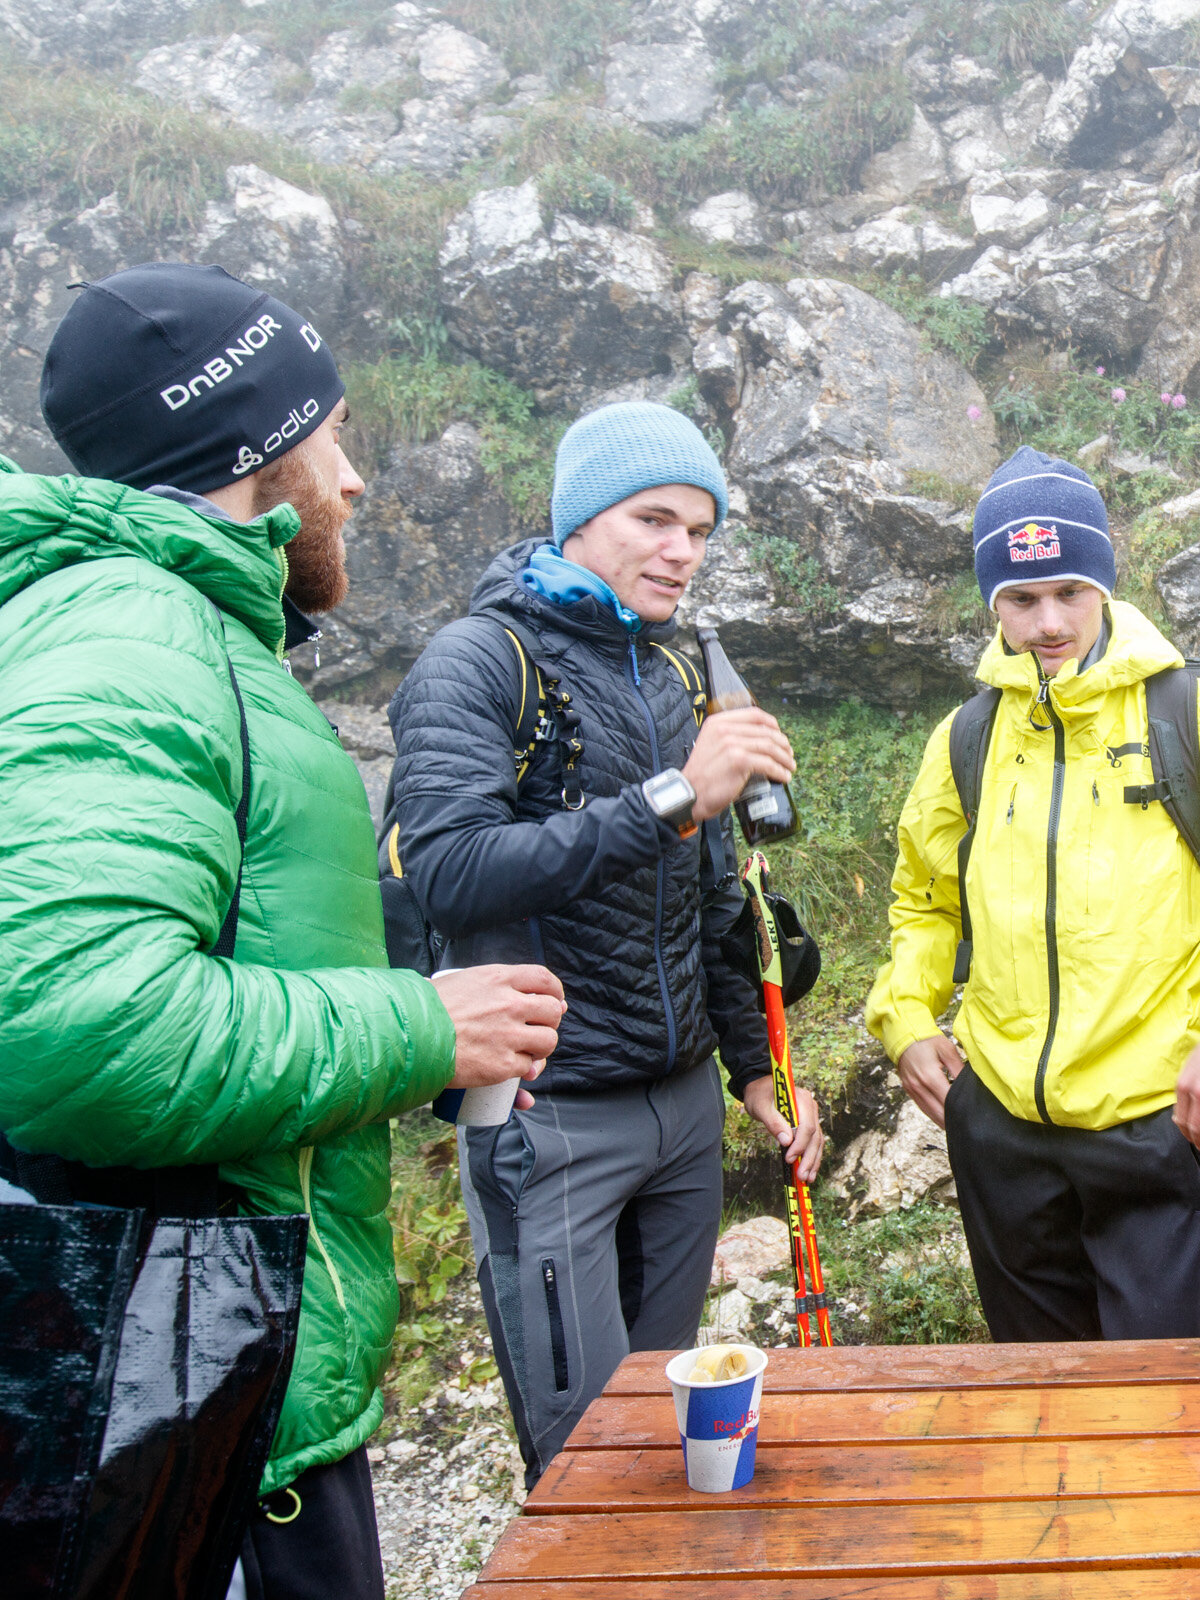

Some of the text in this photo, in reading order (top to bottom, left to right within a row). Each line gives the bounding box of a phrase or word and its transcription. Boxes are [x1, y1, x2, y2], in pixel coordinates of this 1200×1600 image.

[160, 314, 282, 411] DnB NOR
[264, 398, 320, 453] odlo
[1010, 541, 1061, 562] Red Bull
[766, 920, 780, 953] LEKI
[787, 1186, 801, 1237] LEKI
[802, 1186, 816, 1235] LEKI
[713, 1409, 759, 1433] Red Bu
